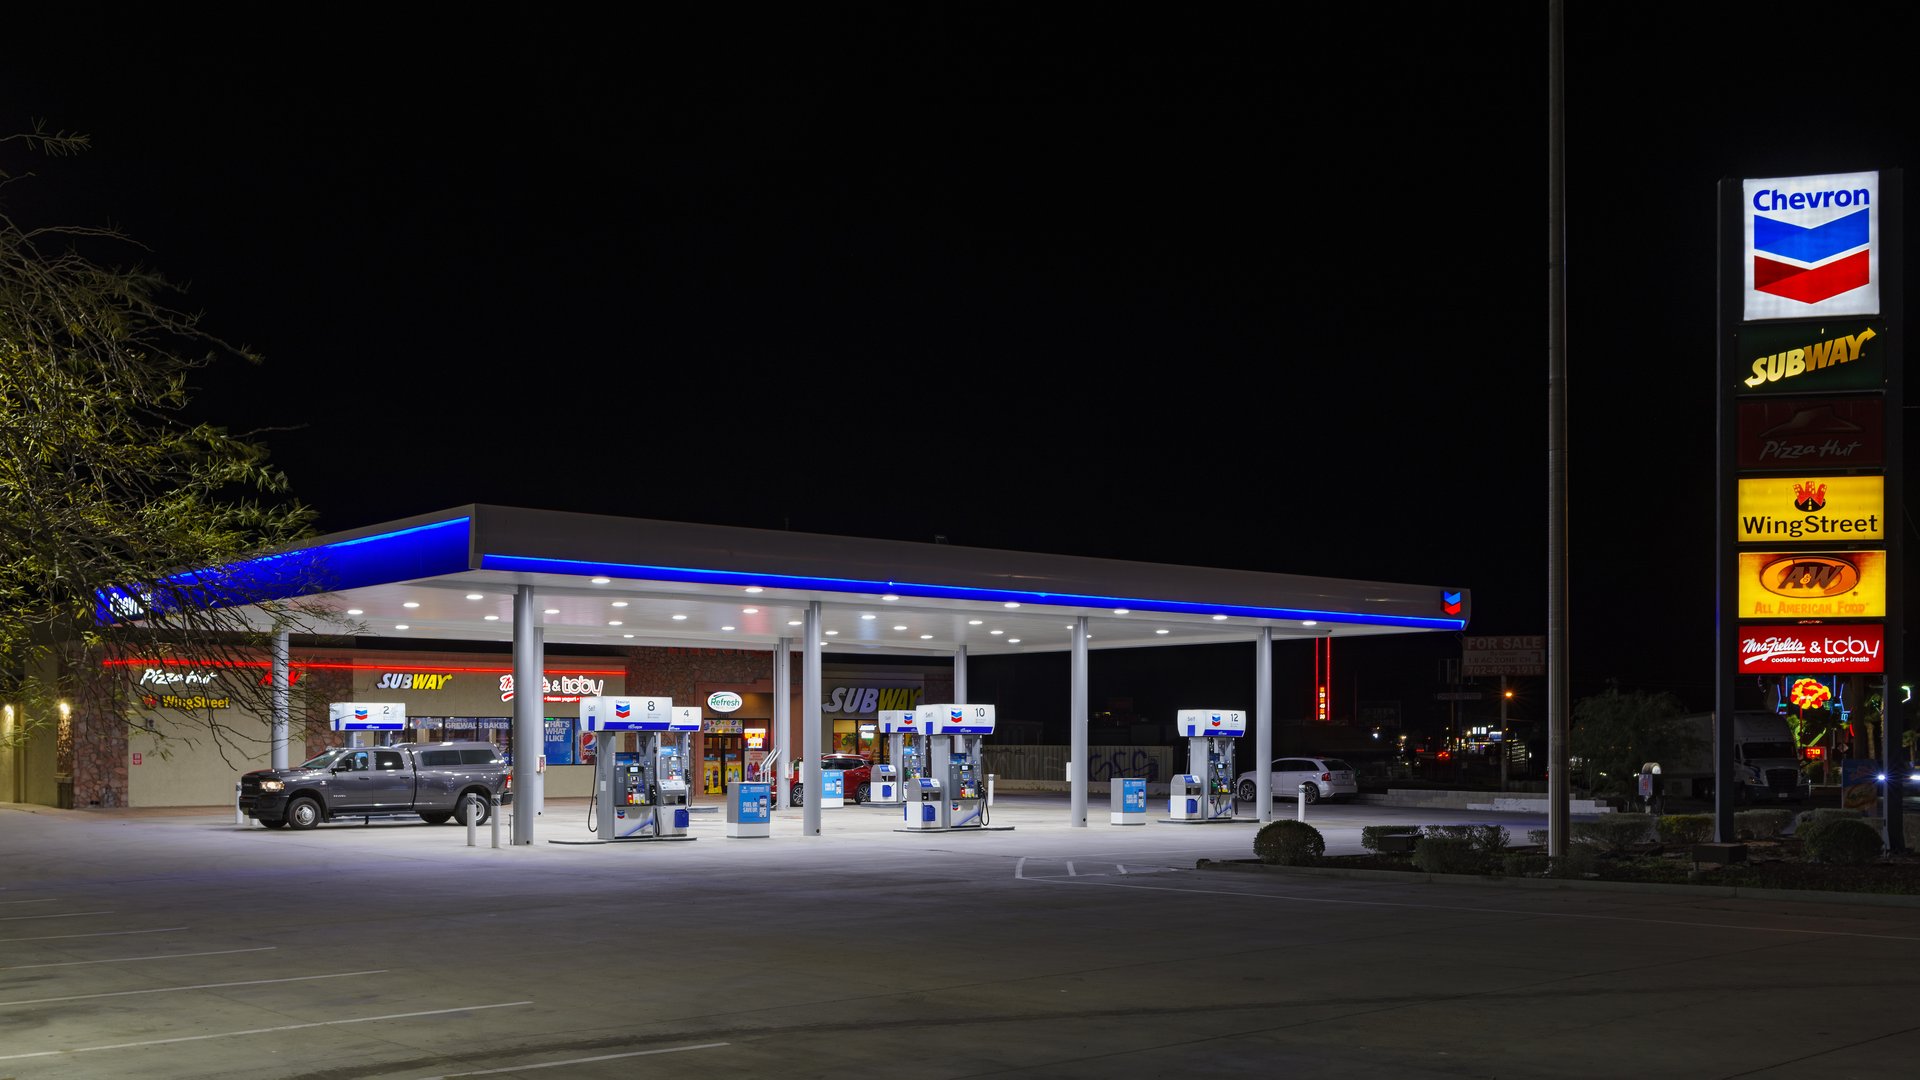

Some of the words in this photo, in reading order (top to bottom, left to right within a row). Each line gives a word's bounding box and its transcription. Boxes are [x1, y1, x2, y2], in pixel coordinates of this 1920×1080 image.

[1753, 188, 1870, 211] Chevron
[1744, 327, 1876, 388] SUBWAY
[1759, 441, 1817, 461] Pizza
[1819, 440, 1862, 457] Hut
[1743, 514, 1878, 538] WingStreet
[1778, 565, 1845, 590] A&W
[1754, 601, 1773, 614] ALL
[1778, 601, 1832, 614] AMERICAN
[1837, 601, 1866, 614] FOOD
[1468, 638, 1498, 649] FOR
[1503, 637, 1541, 649] SALE
[1809, 642, 1821, 654] &
[1824, 636, 1880, 658] tcby
[1823, 656, 1846, 664] yogurt
[140, 669, 184, 685] Pizza
[377, 673, 452, 690] SUBWAY
[551, 680, 561, 692] &
[162, 696, 230, 710] WingStreet
[647, 700, 656, 711] 8
[711, 697, 740, 707] Refresh
[821, 686, 923, 714] SUBWAY
[383, 705, 390, 715] 2
[683, 709, 690, 717] 4
[975, 708, 985, 717] 10
[1230, 713, 1239, 722] 12
